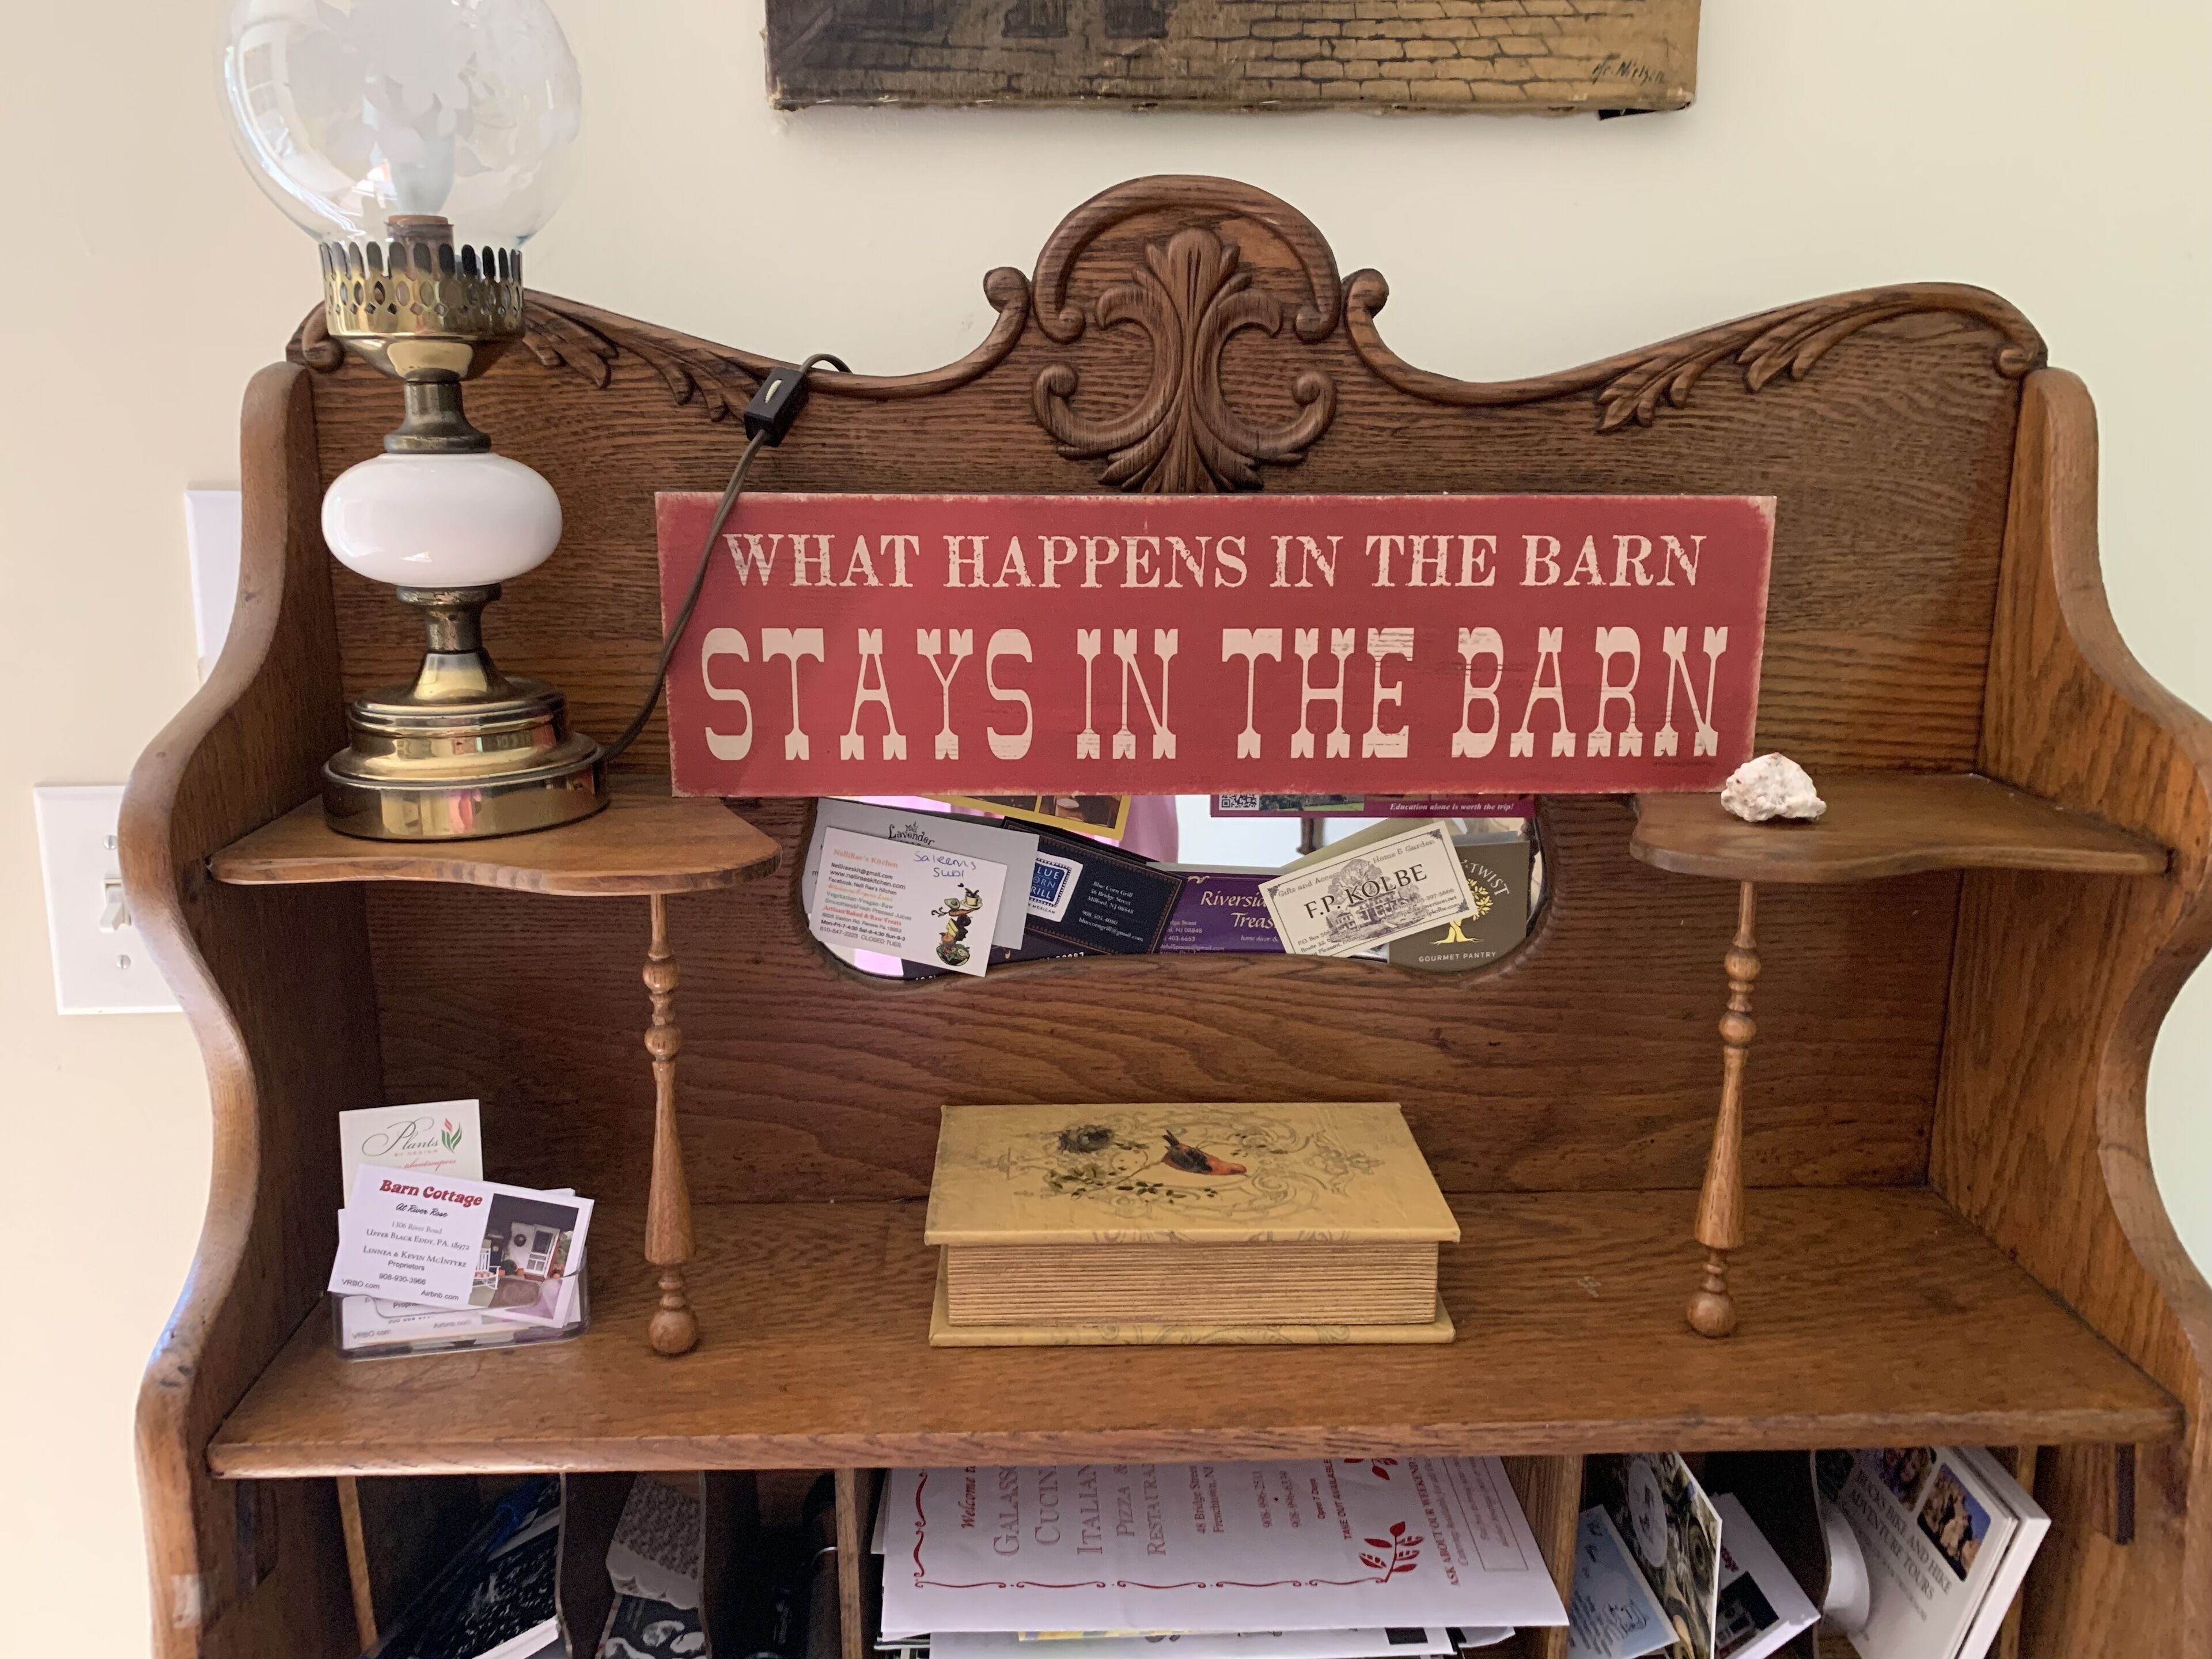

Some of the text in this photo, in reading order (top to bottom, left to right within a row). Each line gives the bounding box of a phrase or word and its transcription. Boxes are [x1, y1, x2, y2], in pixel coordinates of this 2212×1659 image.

[724, 533, 1707, 588] WHAT HAPPENS IN THE BARN
[701, 626, 1729, 760] STAYS IN THE BARN
[888, 824, 935, 846] Lavender
[871, 857, 899, 869] Kitchen
[1278, 887, 1296, 897] Gifts
[1297, 880, 1313, 891] and
[1372, 851, 1396, 864] Home
[1405, 838, 1436, 852] Garden
[1093, 881, 1134, 898] Blue Corn Grill
[1303, 863, 1428, 919] F.P. KOLBE
[1470, 862, 1510, 896] TWIST
[1032, 904, 1056, 914] MEXICAN
[1098, 891, 1115, 902] Bridge
[1109, 902, 1118, 911] NJ
[861, 934, 885, 945] CLOSED
[1418, 951, 1497, 963] GOURMET PANTRY
[361, 1116, 439, 1157] Plants
[379, 1179, 483, 1209] Barn Cottage
[395, 1202, 408, 1211] At
[409, 1203, 431, 1215] River
[366, 1228, 389, 1238] UPPER
[390, 1232, 412, 1243] BLACK
[407, 1222, 425, 1233] River
[425, 1225, 443, 1235] Road
[363, 1245, 392, 1257] LINNEA
[400, 1251, 425, 1263] KEVIN
[387, 1259, 425, 1273] Proprietors
[378, 1272, 427, 1286] 908-930-3966
[960, 1477, 977, 1529] Welcome
[1034, 1465, 1061, 1546] CUCIN
[1115, 1486, 1136, 1537] PIZZA
[1141, 1463, 1166, 1556] RESTAURA
[1191, 1491, 1207, 1522] Bridge
[1323, 1459, 1353, 1540] TAKE OUT AVAILABLE
[1903, 1552, 1936, 1600] TOURS
[1927, 1559, 1953, 1596] HIKE
